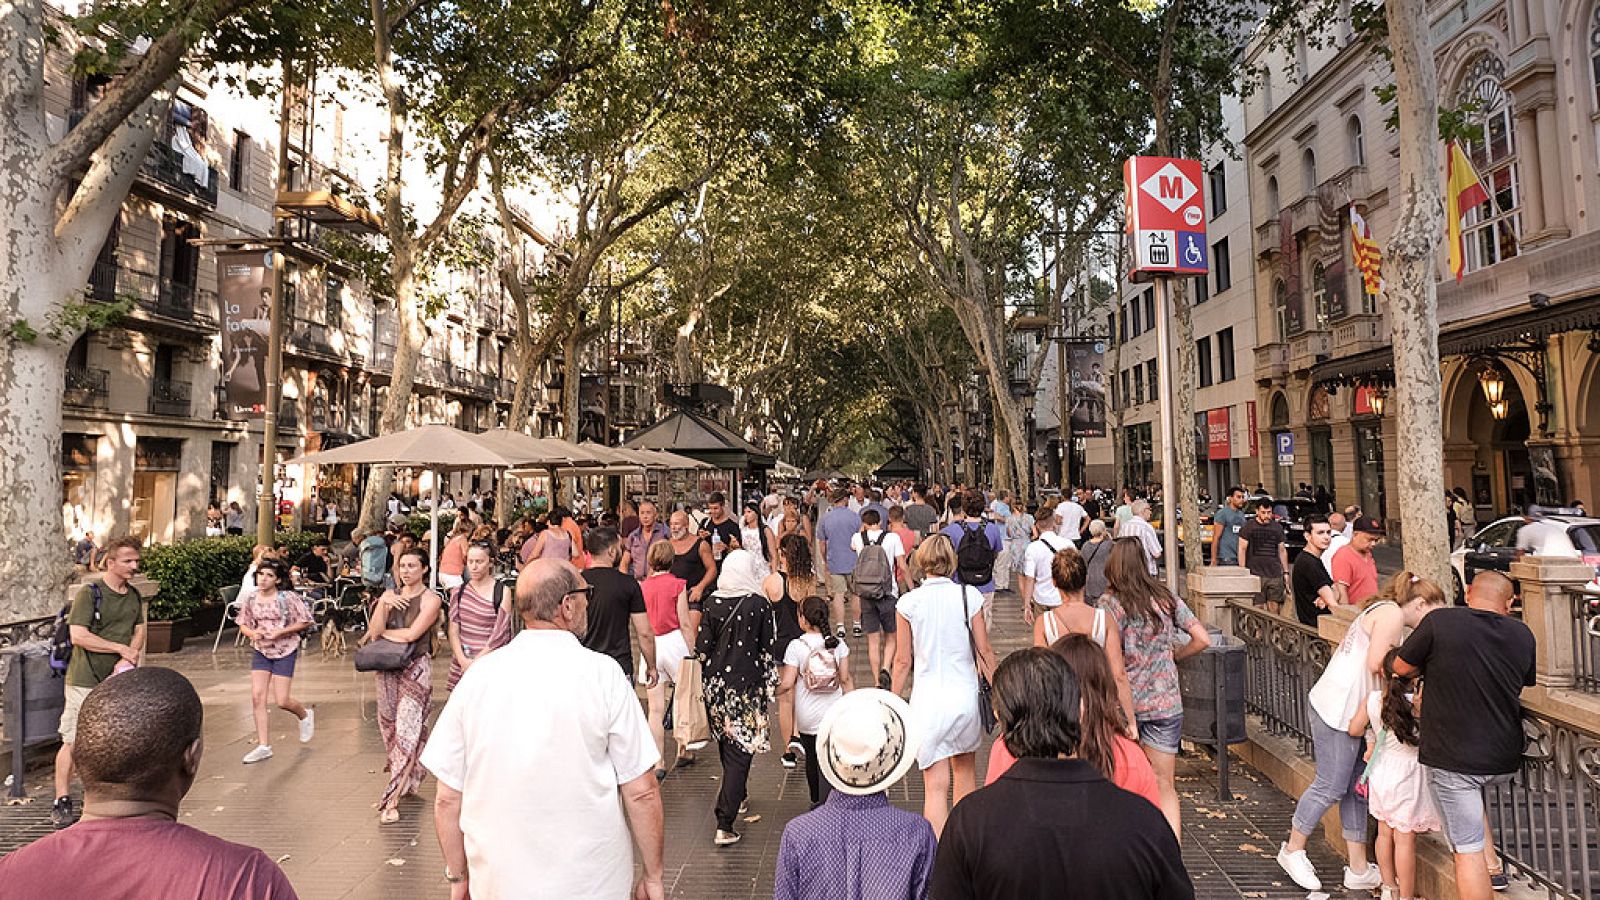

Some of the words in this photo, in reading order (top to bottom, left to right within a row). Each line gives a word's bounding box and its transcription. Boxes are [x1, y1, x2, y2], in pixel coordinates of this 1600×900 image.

[1159, 175, 1184, 199] M
[224, 299, 240, 315] La
[1280, 436, 1292, 453] P
